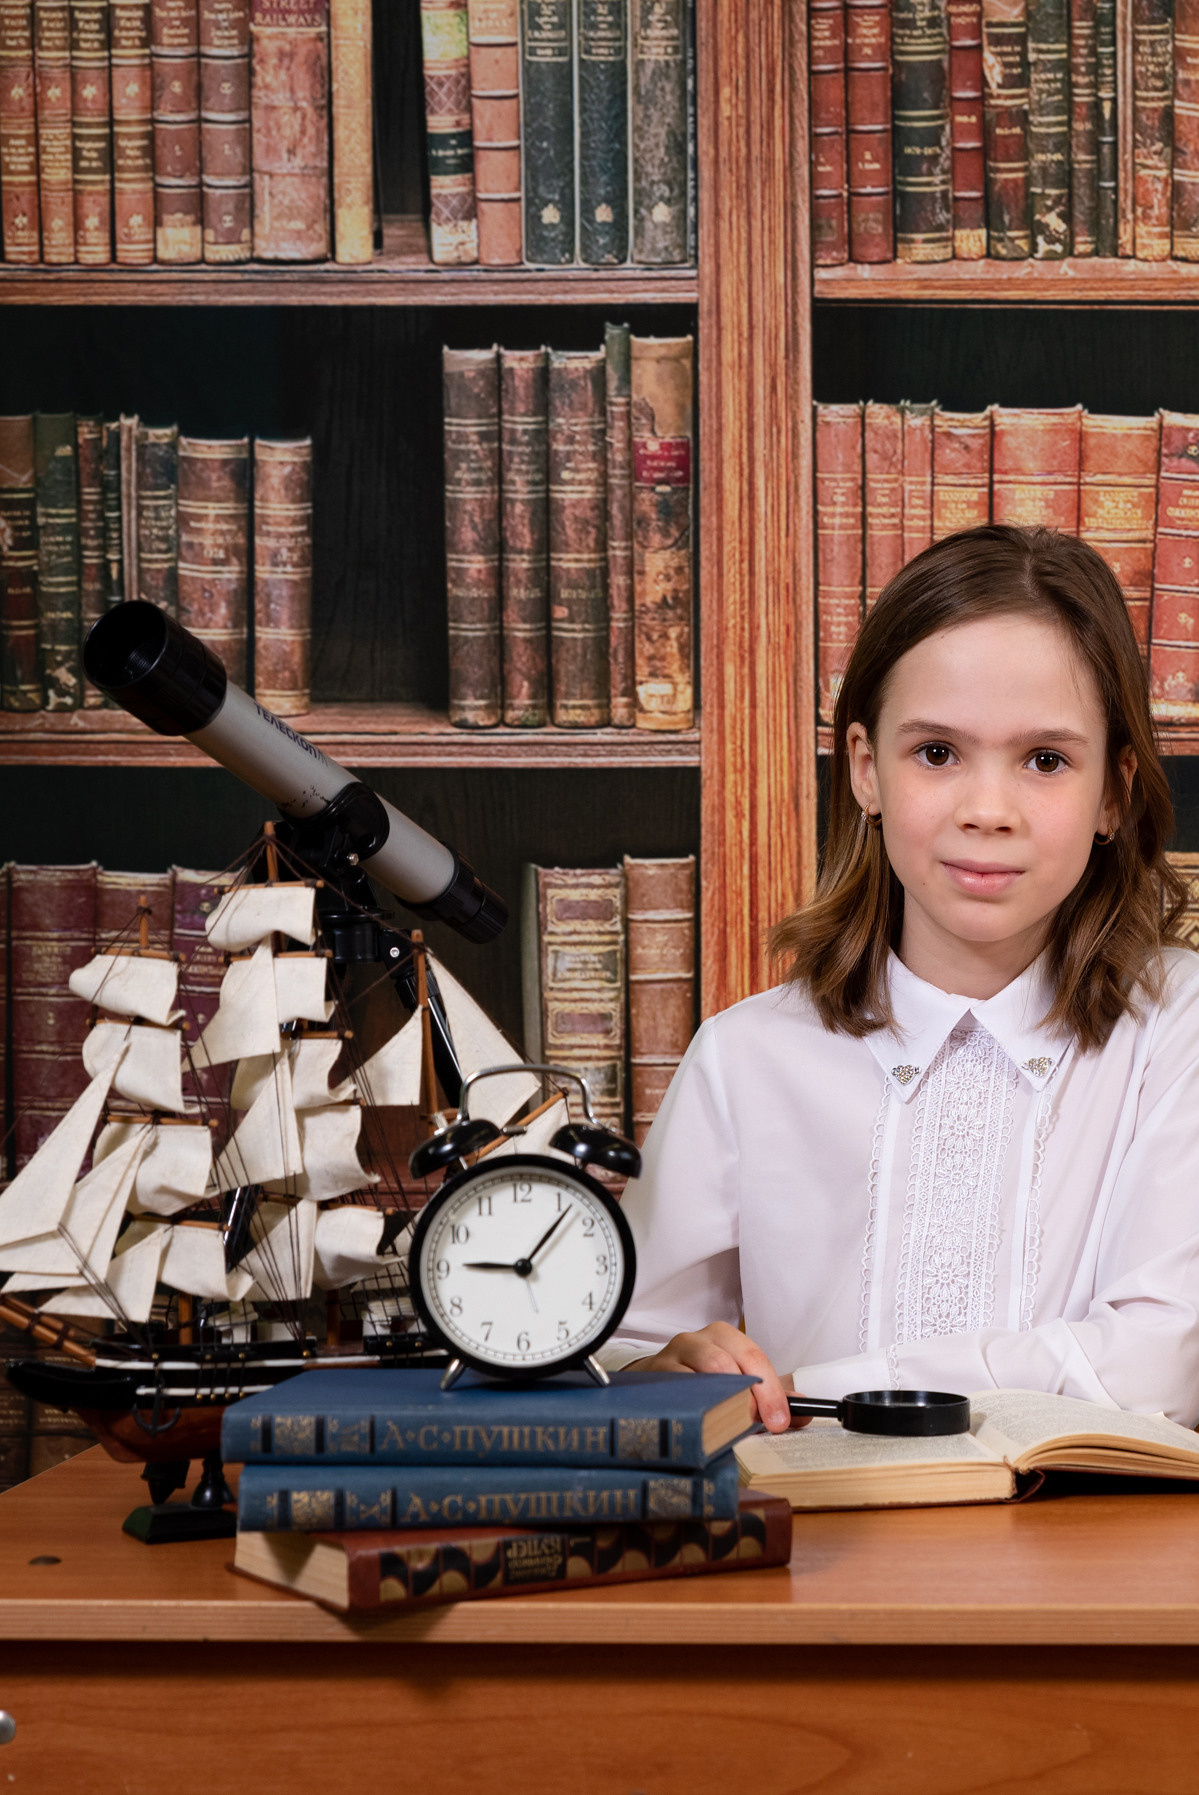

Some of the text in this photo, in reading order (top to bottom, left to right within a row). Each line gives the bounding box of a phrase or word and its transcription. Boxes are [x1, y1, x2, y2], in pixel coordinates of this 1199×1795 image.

[254, 12, 322, 25] RAILWAYS
[254, 702, 318, 759] ТЕЛЕСКОП
[512, 1183, 532, 1203] 12
[556, 1192, 563, 1211] 1
[477, 1196, 493, 1216] 11
[450, 1225, 470, 1244] 10
[582, 1218, 595, 1237] 2
[436, 1260, 450, 1280] 9
[596, 1255, 608, 1275] 3
[450, 1297, 463, 1316] 8
[582, 1291, 595, 1311] 4
[481, 1321, 493, 1342] 7
[557, 1320, 570, 1341] 5
[517, 1332, 531, 1352] 6
[506, 1536, 562, 1558] КУПЕР
